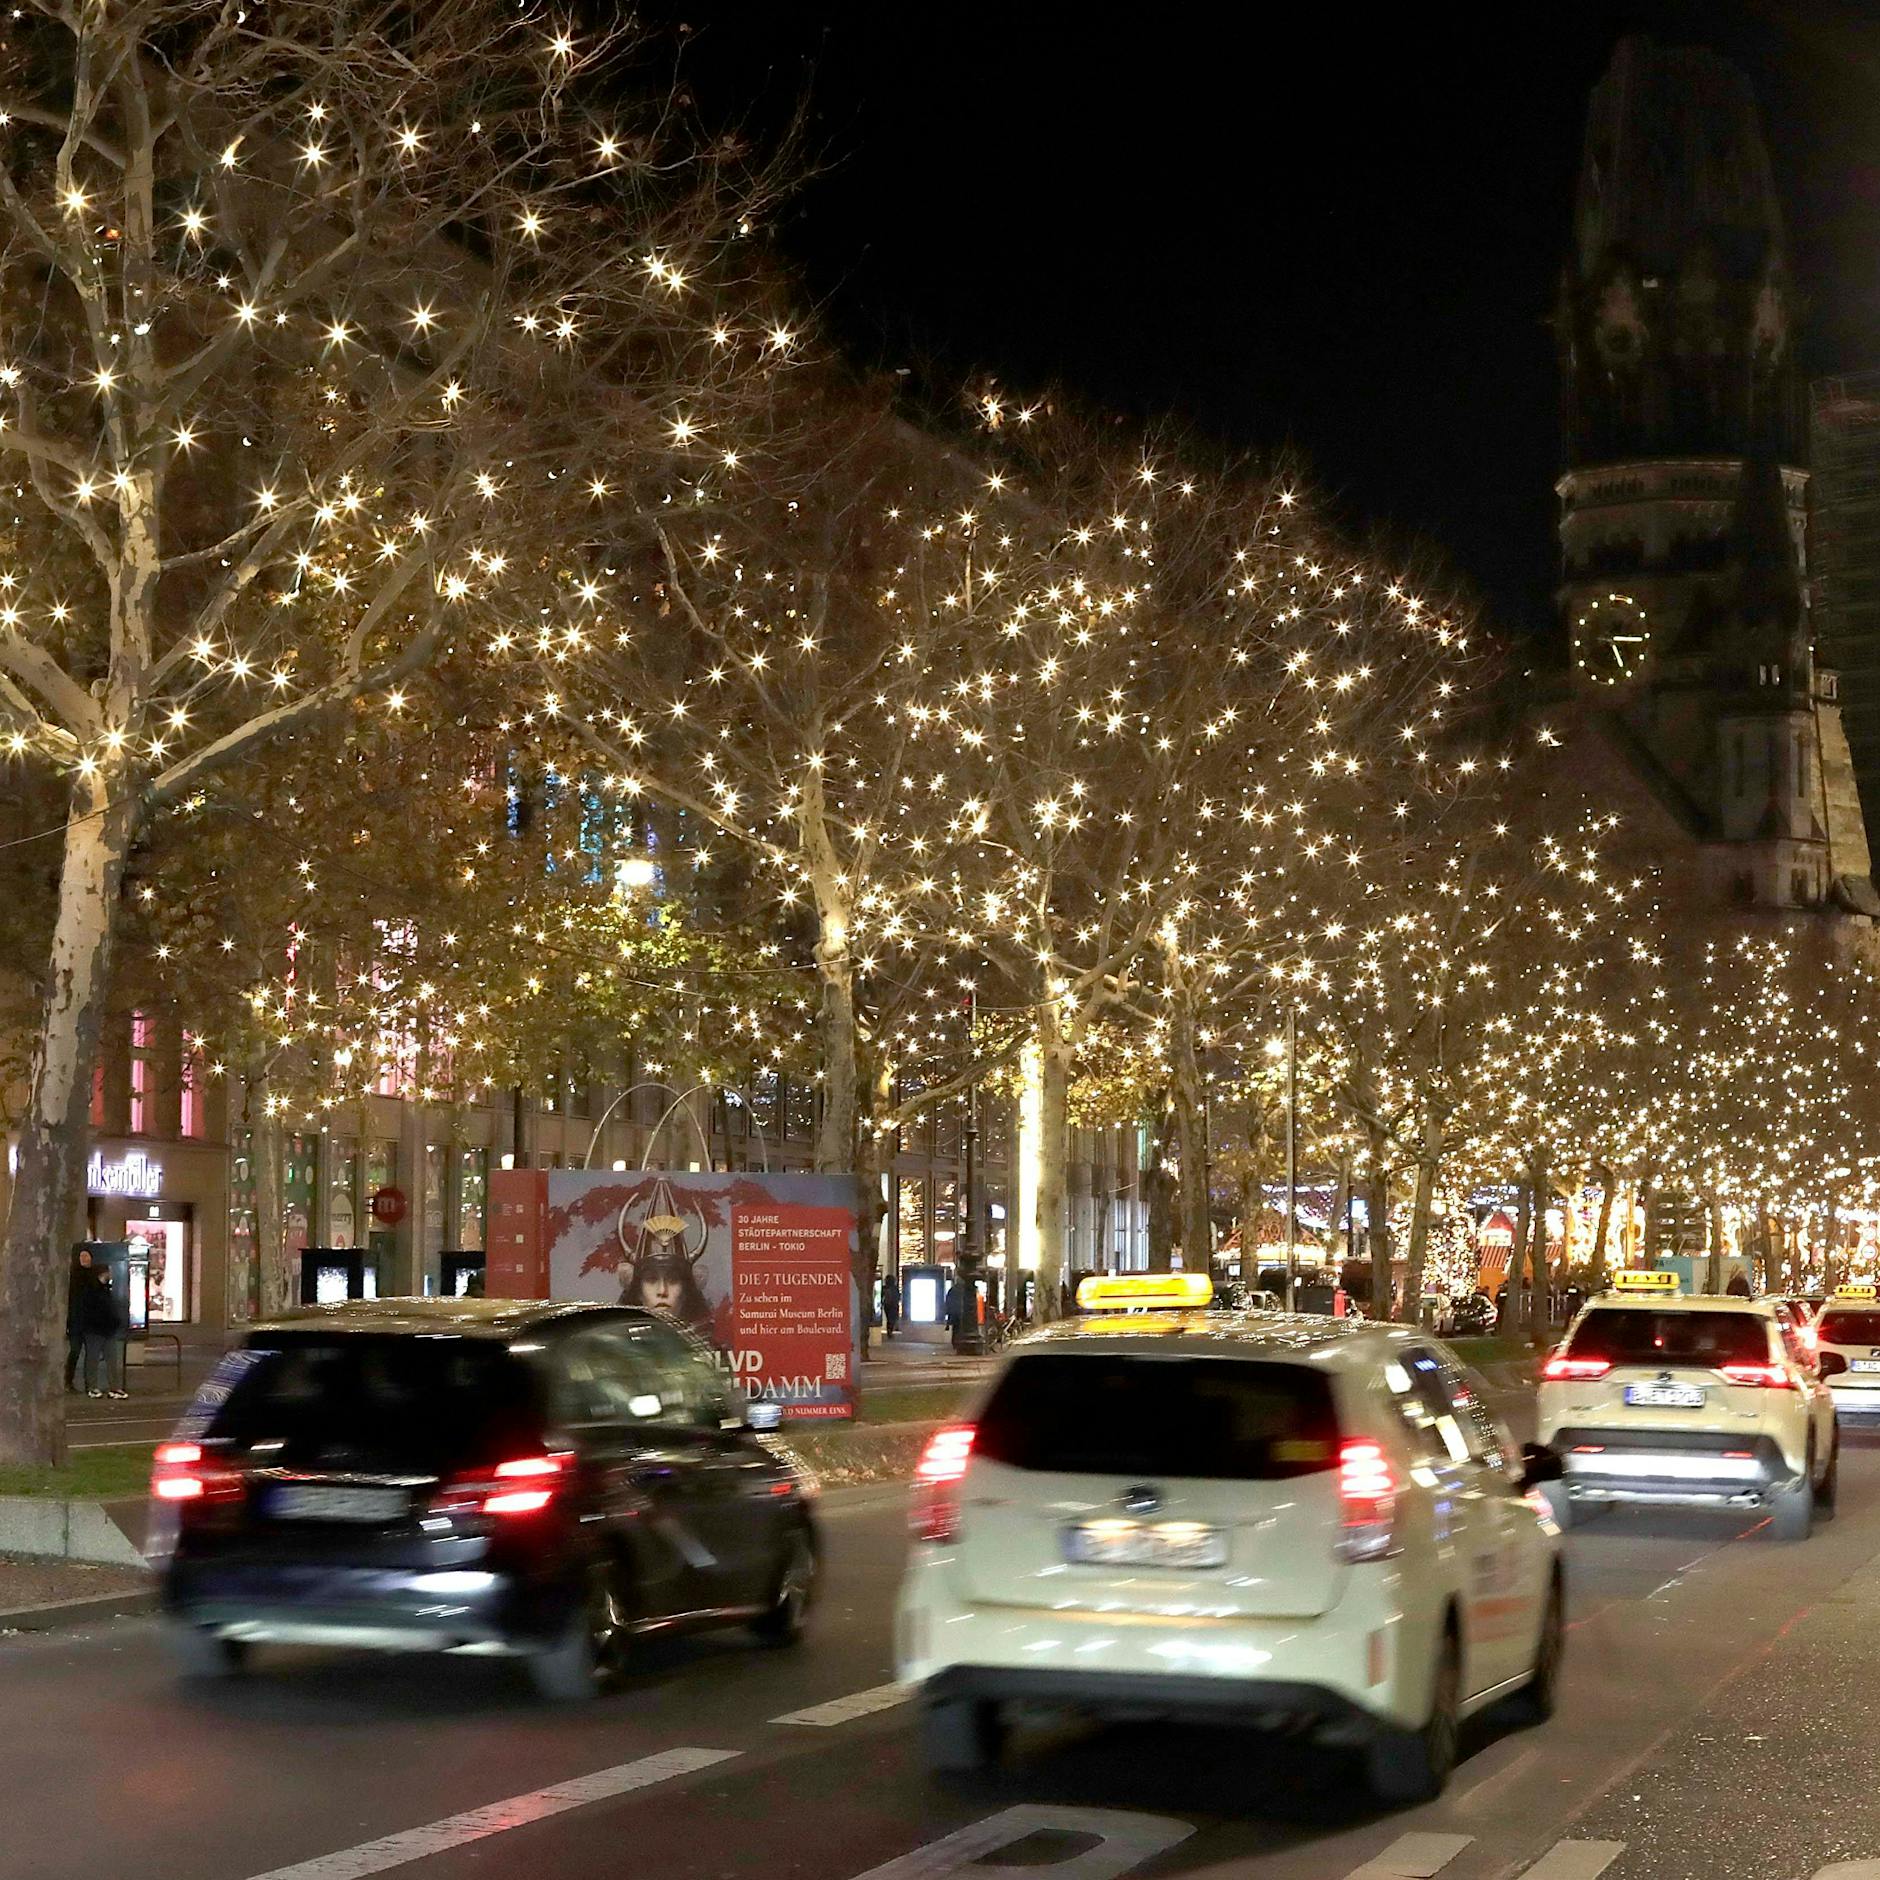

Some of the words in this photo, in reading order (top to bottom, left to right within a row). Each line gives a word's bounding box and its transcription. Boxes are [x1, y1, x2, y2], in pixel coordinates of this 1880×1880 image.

[738, 1215, 749, 1224] 30
[751, 1215, 779, 1224] JAHRE
[738, 1227, 842, 1238] STÄDTEPARTNERSCHAFT
[738, 1242, 770, 1251] BERLIN
[779, 1242, 805, 1251] TOKIO
[740, 1273, 761, 1286] DIE
[763, 1273, 770, 1285] 7
[773, 1273, 843, 1286] TUGENDEN
[740, 1292, 752, 1303] Zu
[754, 1292, 779, 1303] sehen
[781, 1293, 792, 1303] im
[740, 1309, 777, 1319] Samurai
[780, 1309, 815, 1319] Museum
[818, 1307, 843, 1318] Berlin
[740, 1323, 758, 1335] und
[760, 1323, 778, 1335] hier
[781, 1326, 794, 1334] am
[797, 1323, 844, 1334] Boulevard.
[714, 1350, 763, 1372] LVD
